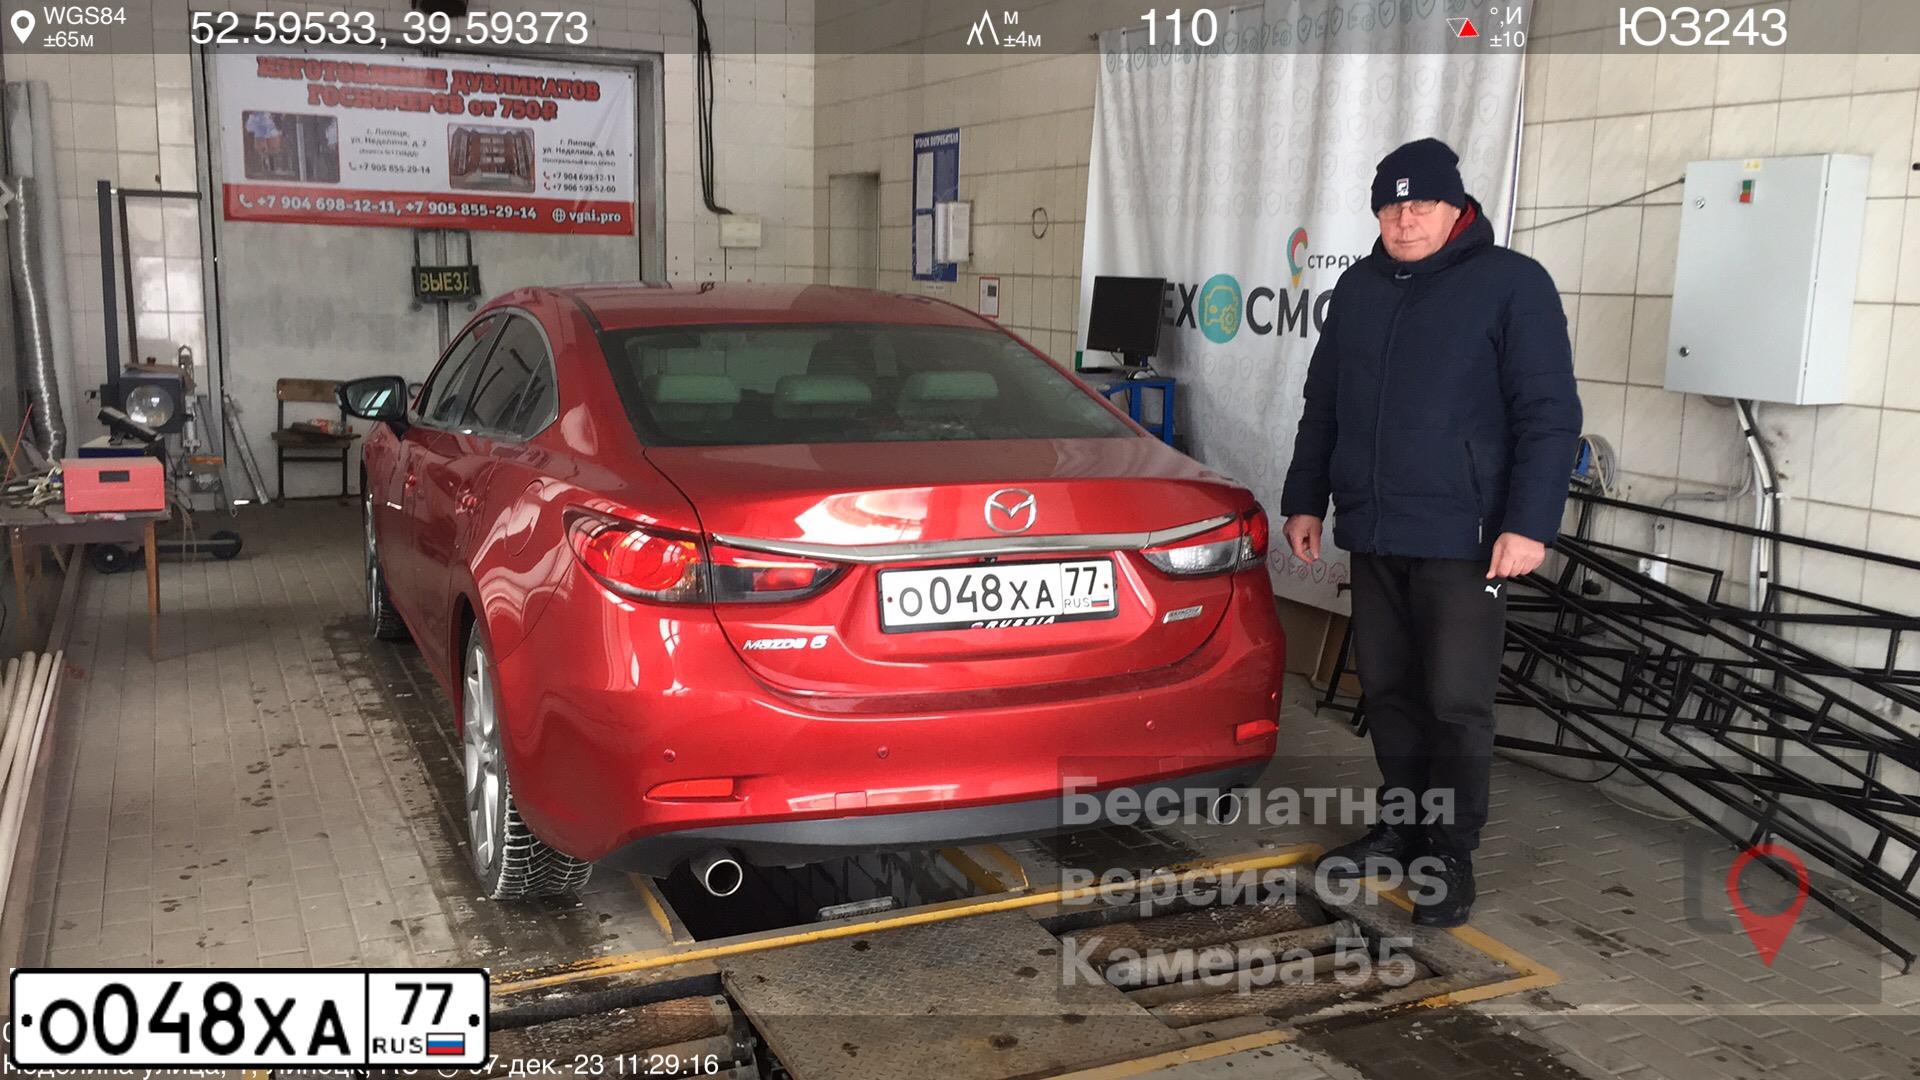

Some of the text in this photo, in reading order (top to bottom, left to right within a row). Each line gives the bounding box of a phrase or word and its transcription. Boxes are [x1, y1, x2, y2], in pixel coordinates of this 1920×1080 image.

[451, 69, 601, 102] ДУБЛИКАТОВ
[256, 195, 276, 208] +7
[281, 197, 311, 211] 904
[405, 200, 423, 213] +7
[428, 202, 457, 215] 905
[460, 204, 538, 220] 855-29-14
[568, 211, 622, 224] vgai.pro
[899, 573, 1056, 617] О048ХА
[1064, 566, 1097, 596] 77
[1064, 597, 1091, 609] RUS
[809, 634, 829, 649] 6
